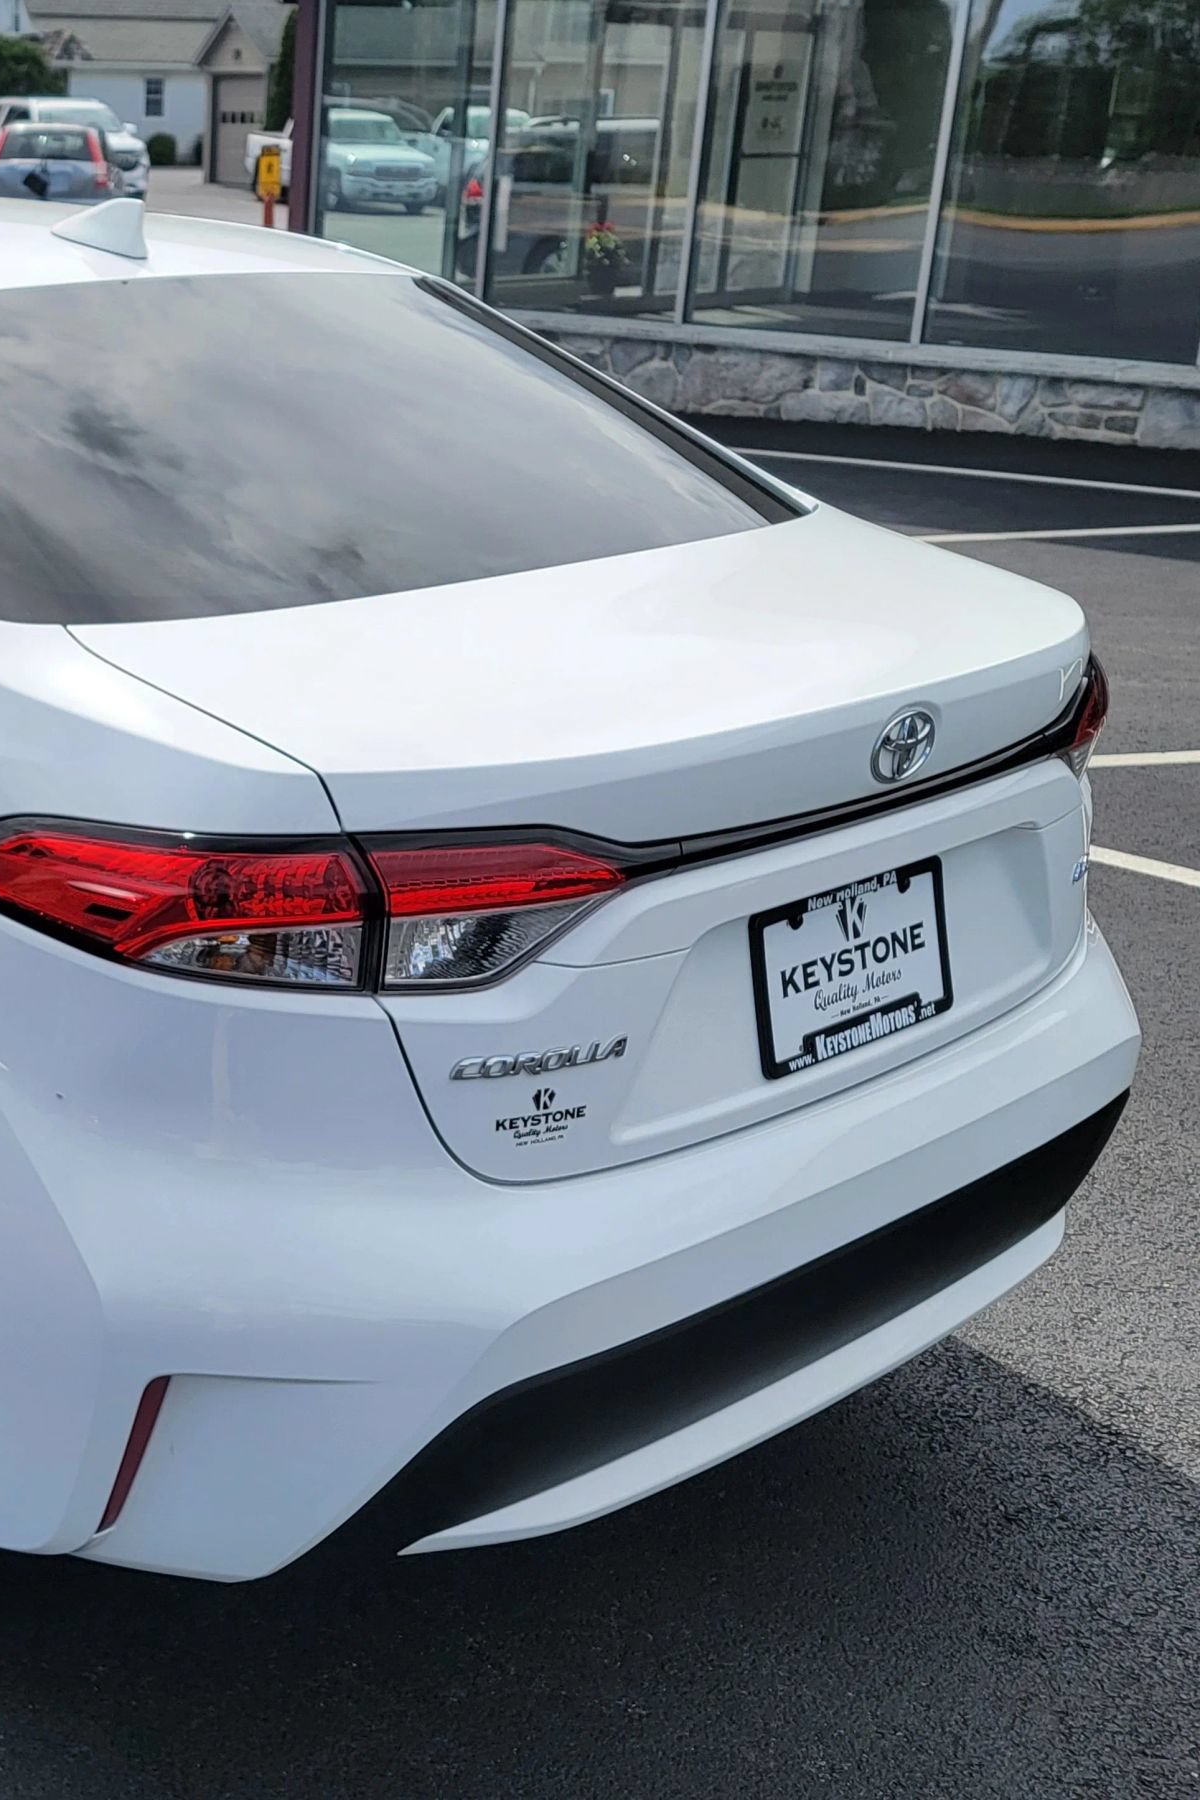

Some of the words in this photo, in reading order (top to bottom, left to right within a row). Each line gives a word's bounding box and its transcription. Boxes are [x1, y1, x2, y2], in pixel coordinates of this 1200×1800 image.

[808, 894, 833, 911] New
[883, 870, 898, 886] PA
[780, 922, 926, 999] KEYSTONE
[814, 983, 860, 1011] Quality
[862, 967, 902, 993] Motors
[449, 1031, 628, 1081] COROLLA
[495, 1105, 587, 1132] KEYSTONE
[513, 1128, 541, 1140] Quality
[543, 1124, 569, 1134] Motors
